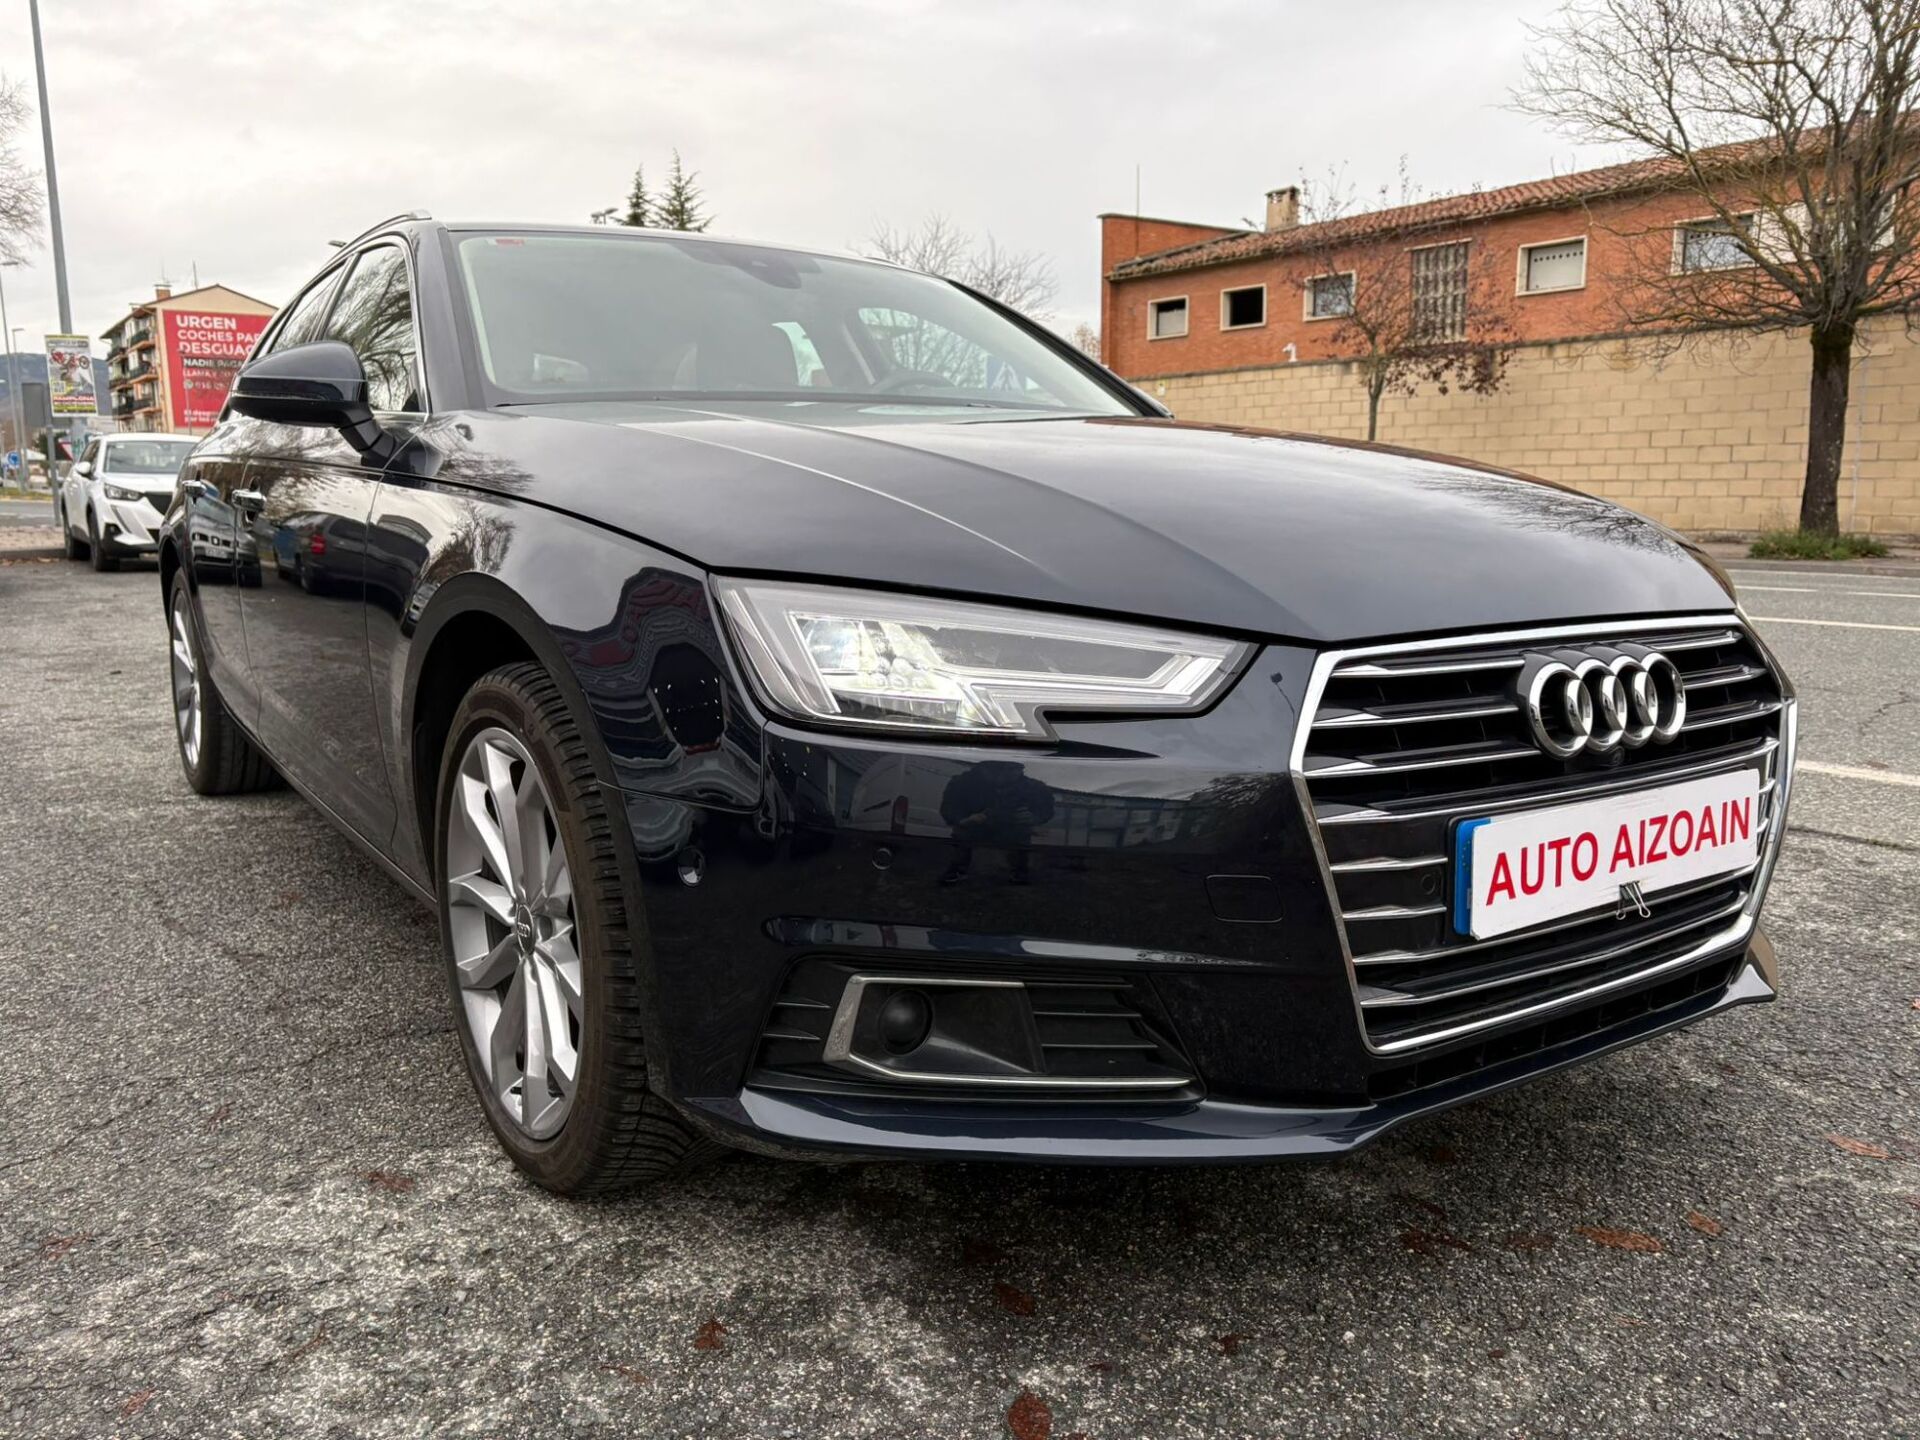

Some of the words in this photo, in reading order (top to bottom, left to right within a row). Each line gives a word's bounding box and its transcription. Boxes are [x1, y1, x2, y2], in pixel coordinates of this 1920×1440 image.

[176, 314, 237, 330] URGEN
[177, 329, 233, 342] COCHES
[1486, 832, 1598, 905] AUTO
[1610, 797, 1750, 873] AIZOAIN
